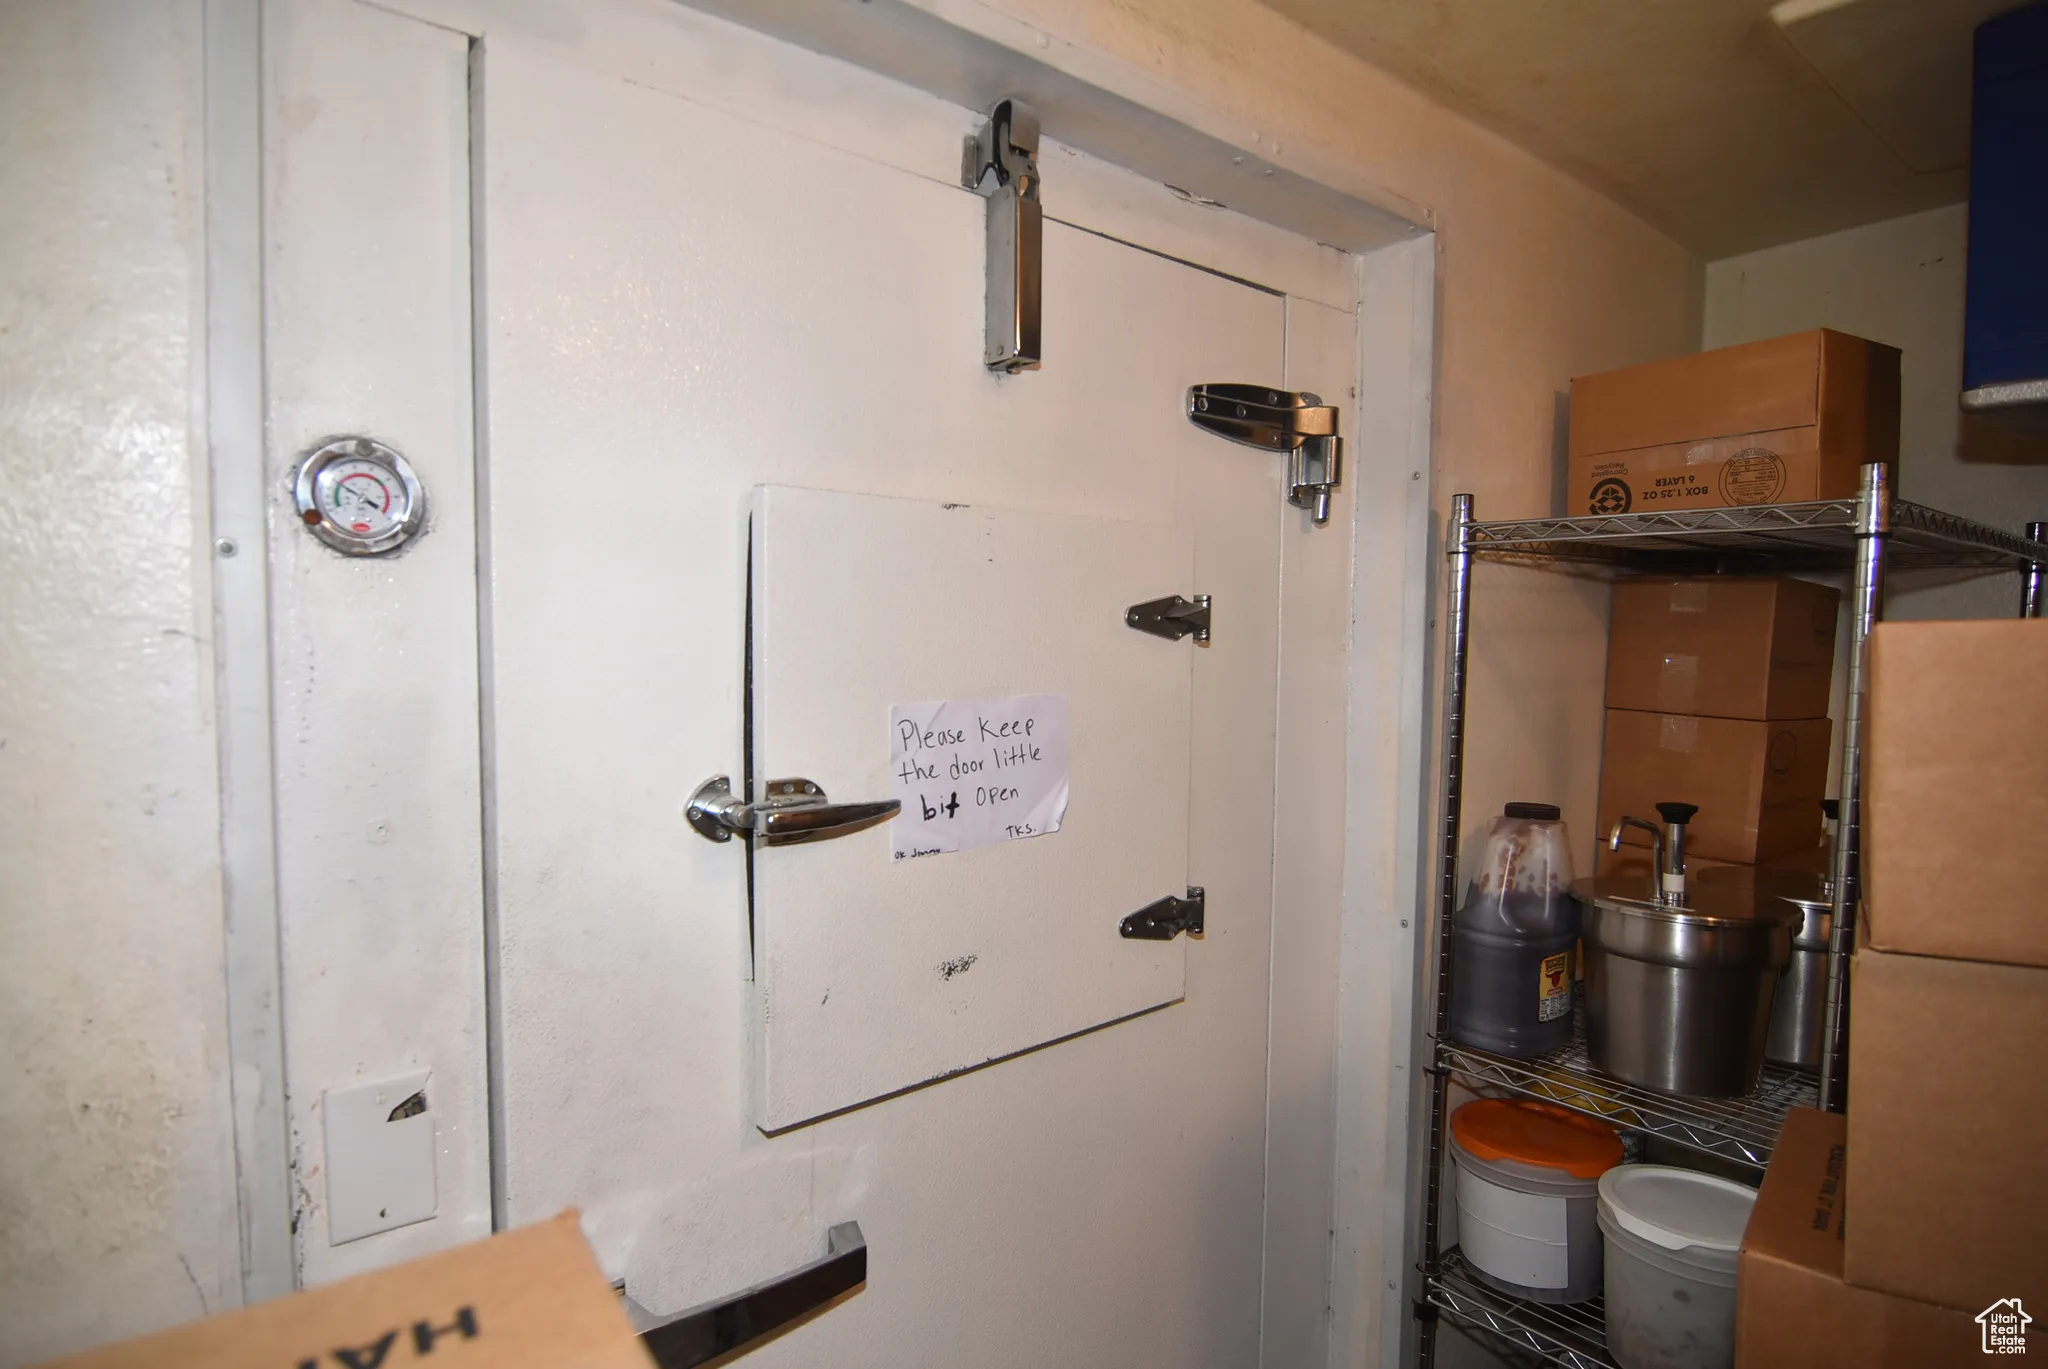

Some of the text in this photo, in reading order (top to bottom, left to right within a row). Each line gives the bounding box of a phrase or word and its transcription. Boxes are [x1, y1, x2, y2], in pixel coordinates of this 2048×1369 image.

[1642, 485, 1709, 500] BOX 1.25 OZ
[1654, 475, 1696, 488] 6 LAYER
[897, 719, 966, 752] Please
[898, 743, 1042, 785] the door little
[920, 791, 960, 821] bit
[297, 1305, 479, 1369] HA
